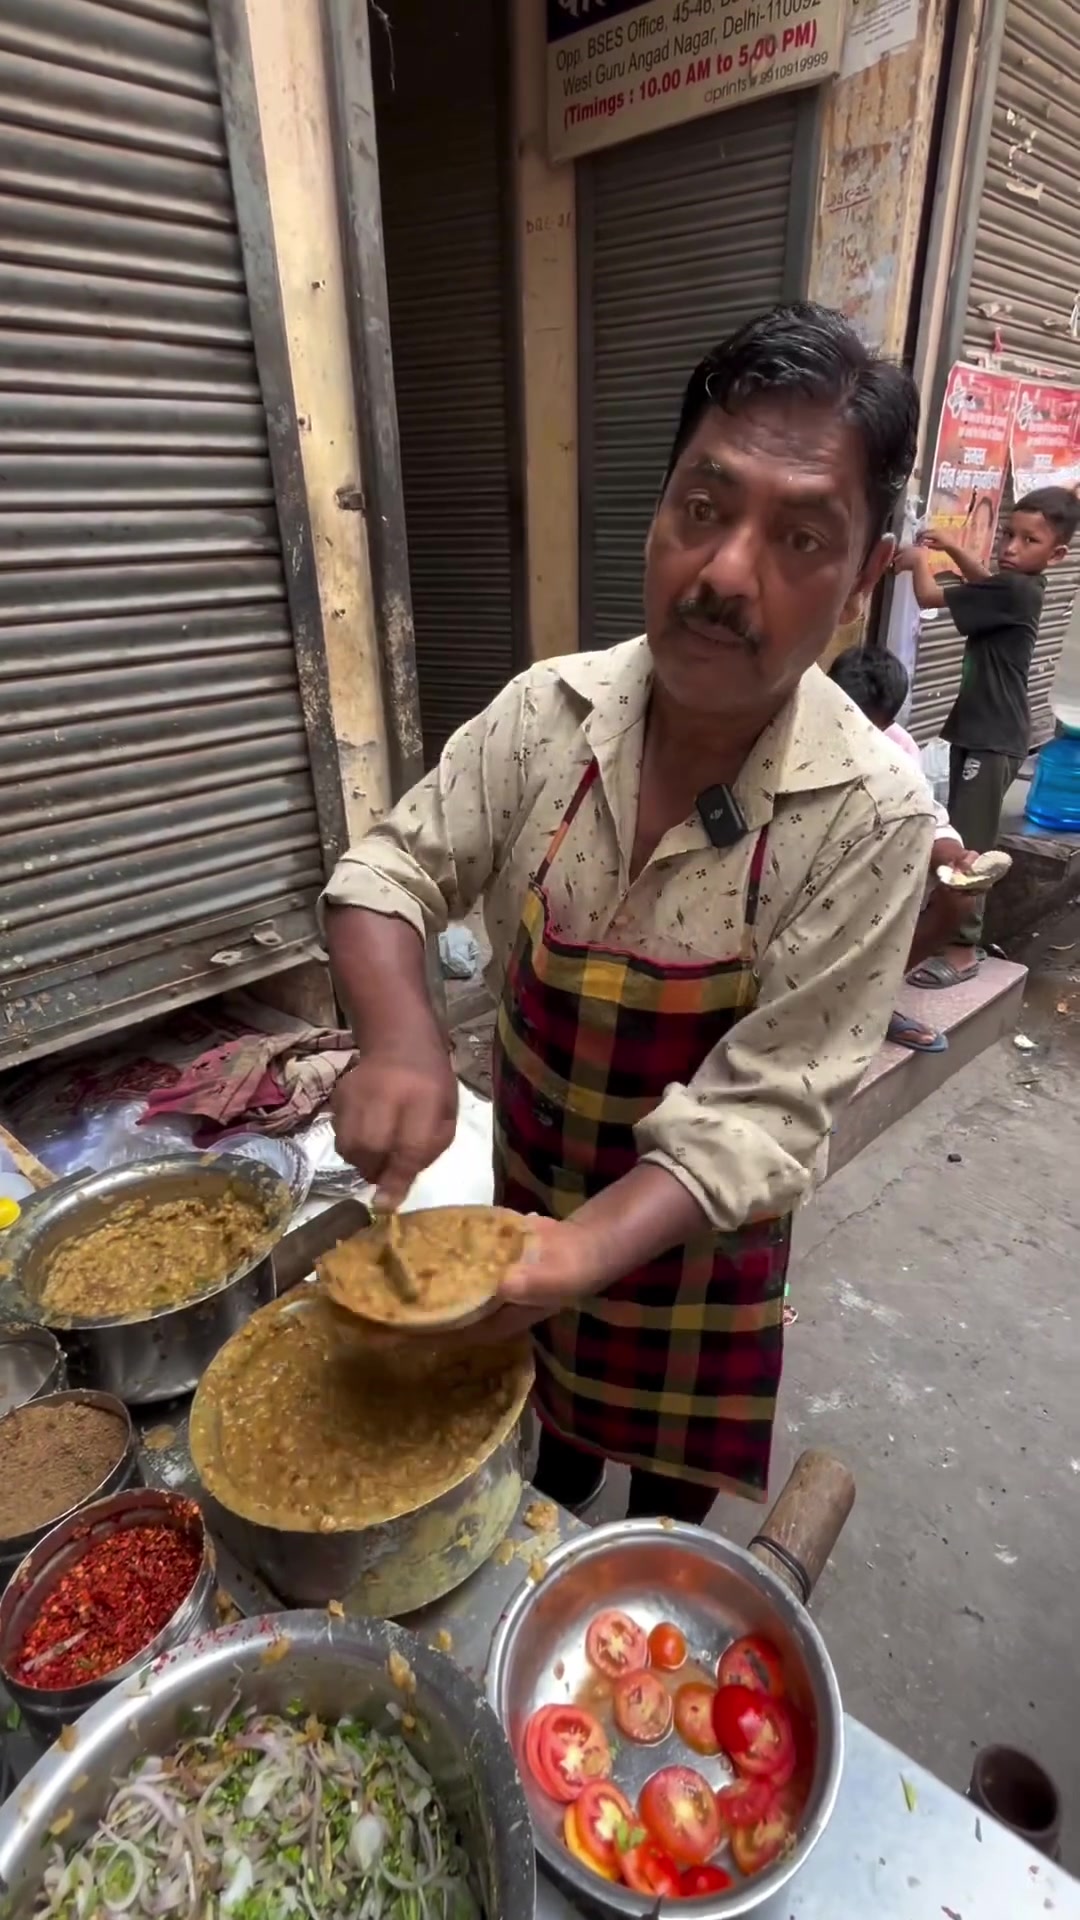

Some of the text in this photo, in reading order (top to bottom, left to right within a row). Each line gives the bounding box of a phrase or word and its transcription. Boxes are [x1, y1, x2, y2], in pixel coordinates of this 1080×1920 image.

[563, 70, 592, 96] West
[595, 60, 626, 84] Guru
[628, 40, 669, 73] Angad
[673, 27, 718, 56] Nagar,
[588, 26, 623, 59] BSES
[627, 15, 668, 42] Office,
[564, 92, 625, 133] (Timings
[640, 68, 681, 100] 10.00
[685, 57, 711, 85] AM
[717, 53, 733, 75] to
[782, 18, 817, 52] PM)
